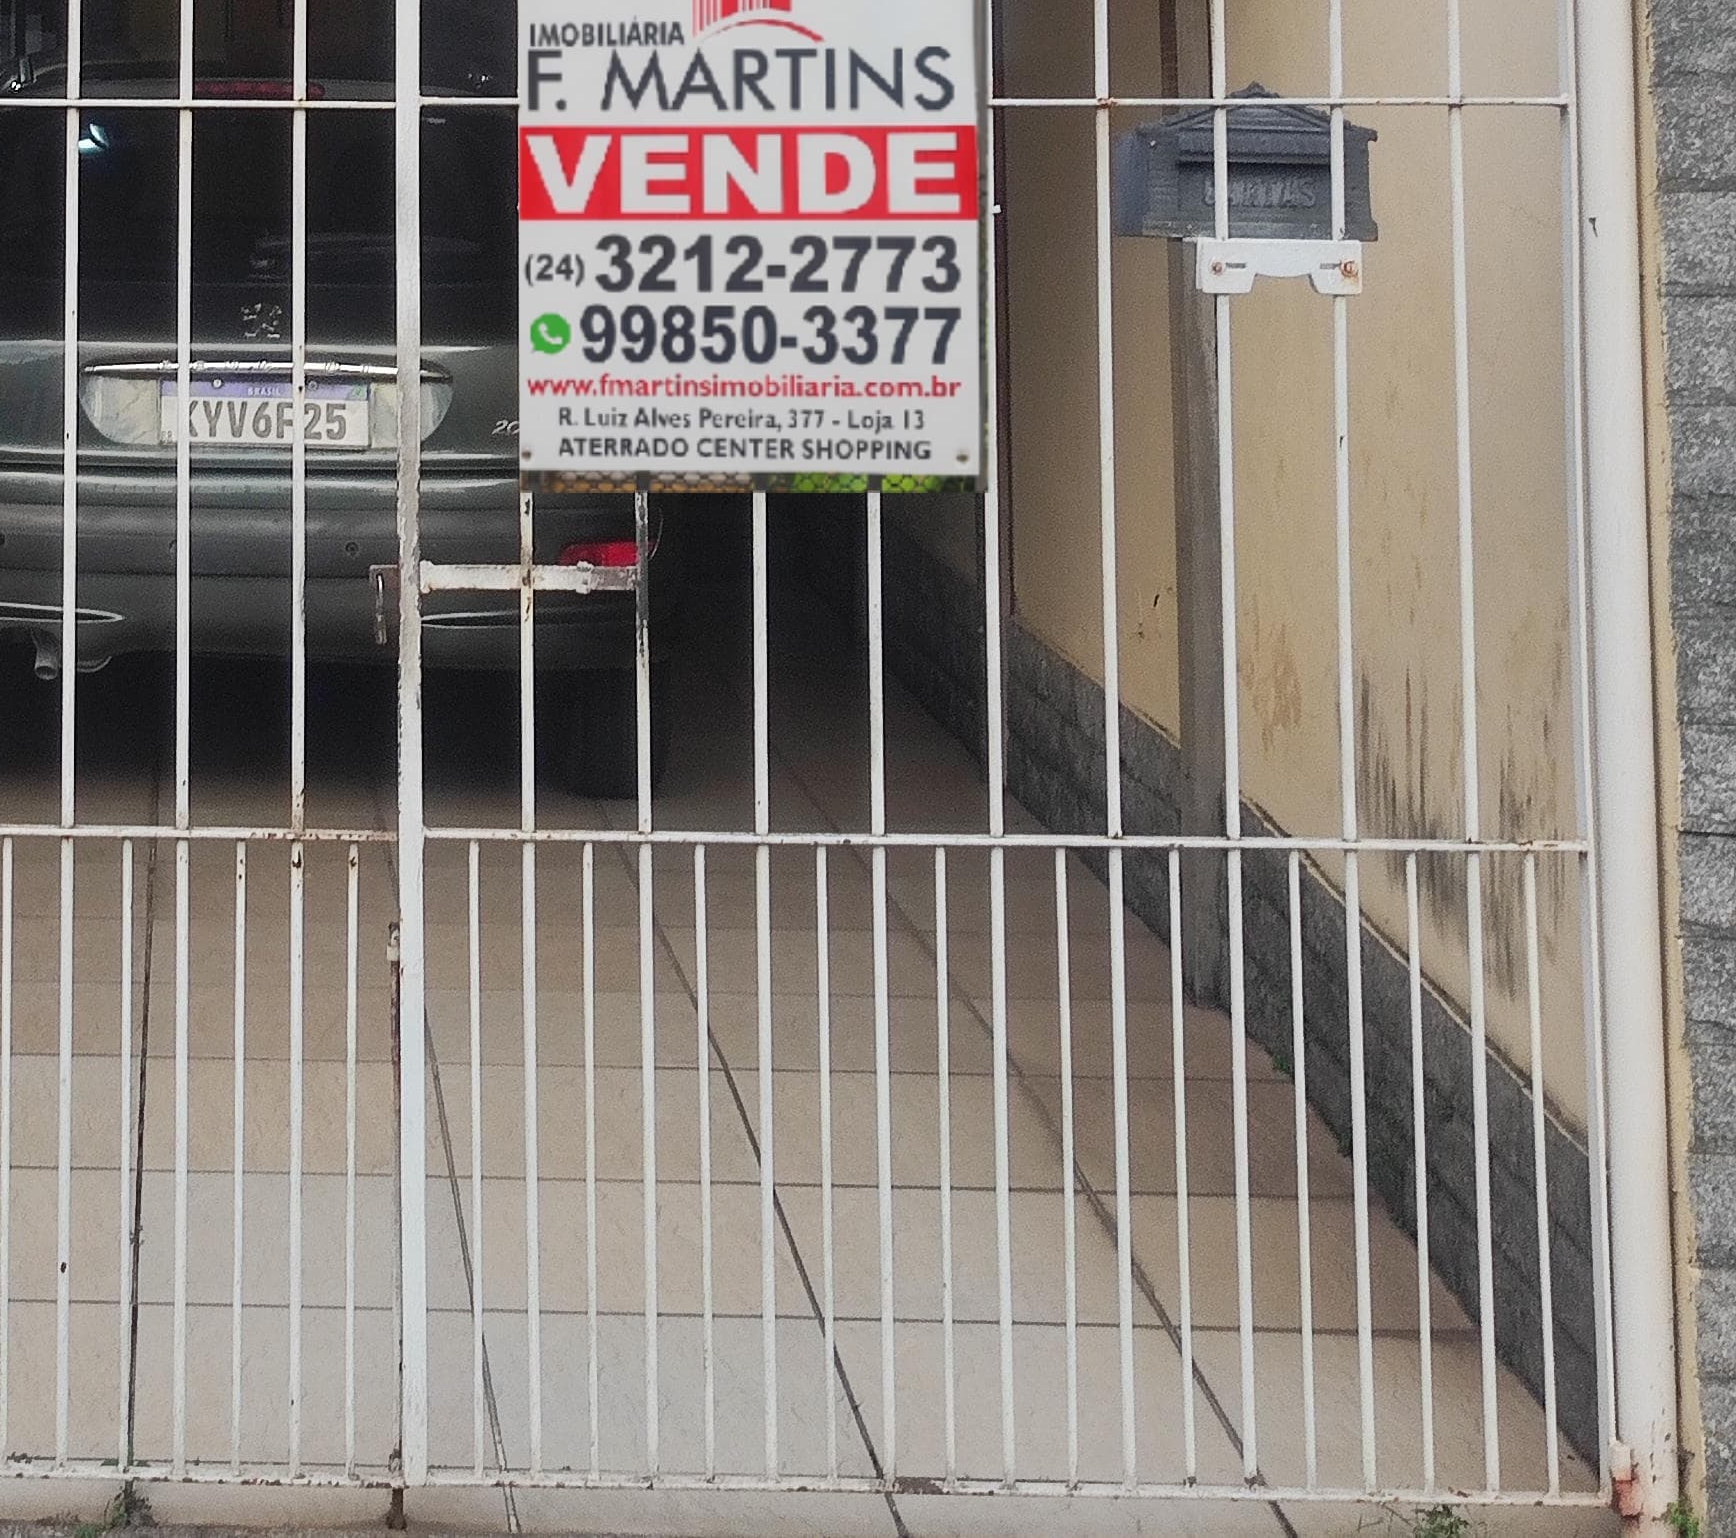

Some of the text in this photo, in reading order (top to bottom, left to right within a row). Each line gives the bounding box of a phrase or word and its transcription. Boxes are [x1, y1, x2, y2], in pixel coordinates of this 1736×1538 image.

[529, 15, 685, 47] IMOBILIÁRIA
[527, 45, 956, 112] F. MARTINS
[526, 132, 961, 215] VENDE
[524, 234, 962, 293] (24) 3212-2773
[579, 304, 962, 366] 99850-3377
[247, 387, 281, 397] BRASIL
[527, 373, 963, 399] www.fmartinsimobiliaria.com.br
[558, 407, 579, 427] R.
[584, 407, 628, 428] Luiz
[633, 407, 692, 429] Alves
[698, 408, 782, 432] Pereira,
[787, 409, 824, 429] 377
[847, 410, 894, 435] Loja
[903, 410, 925, 430] 13
[558, 437, 932, 461] ATERRADO CENTER SHOPPING
